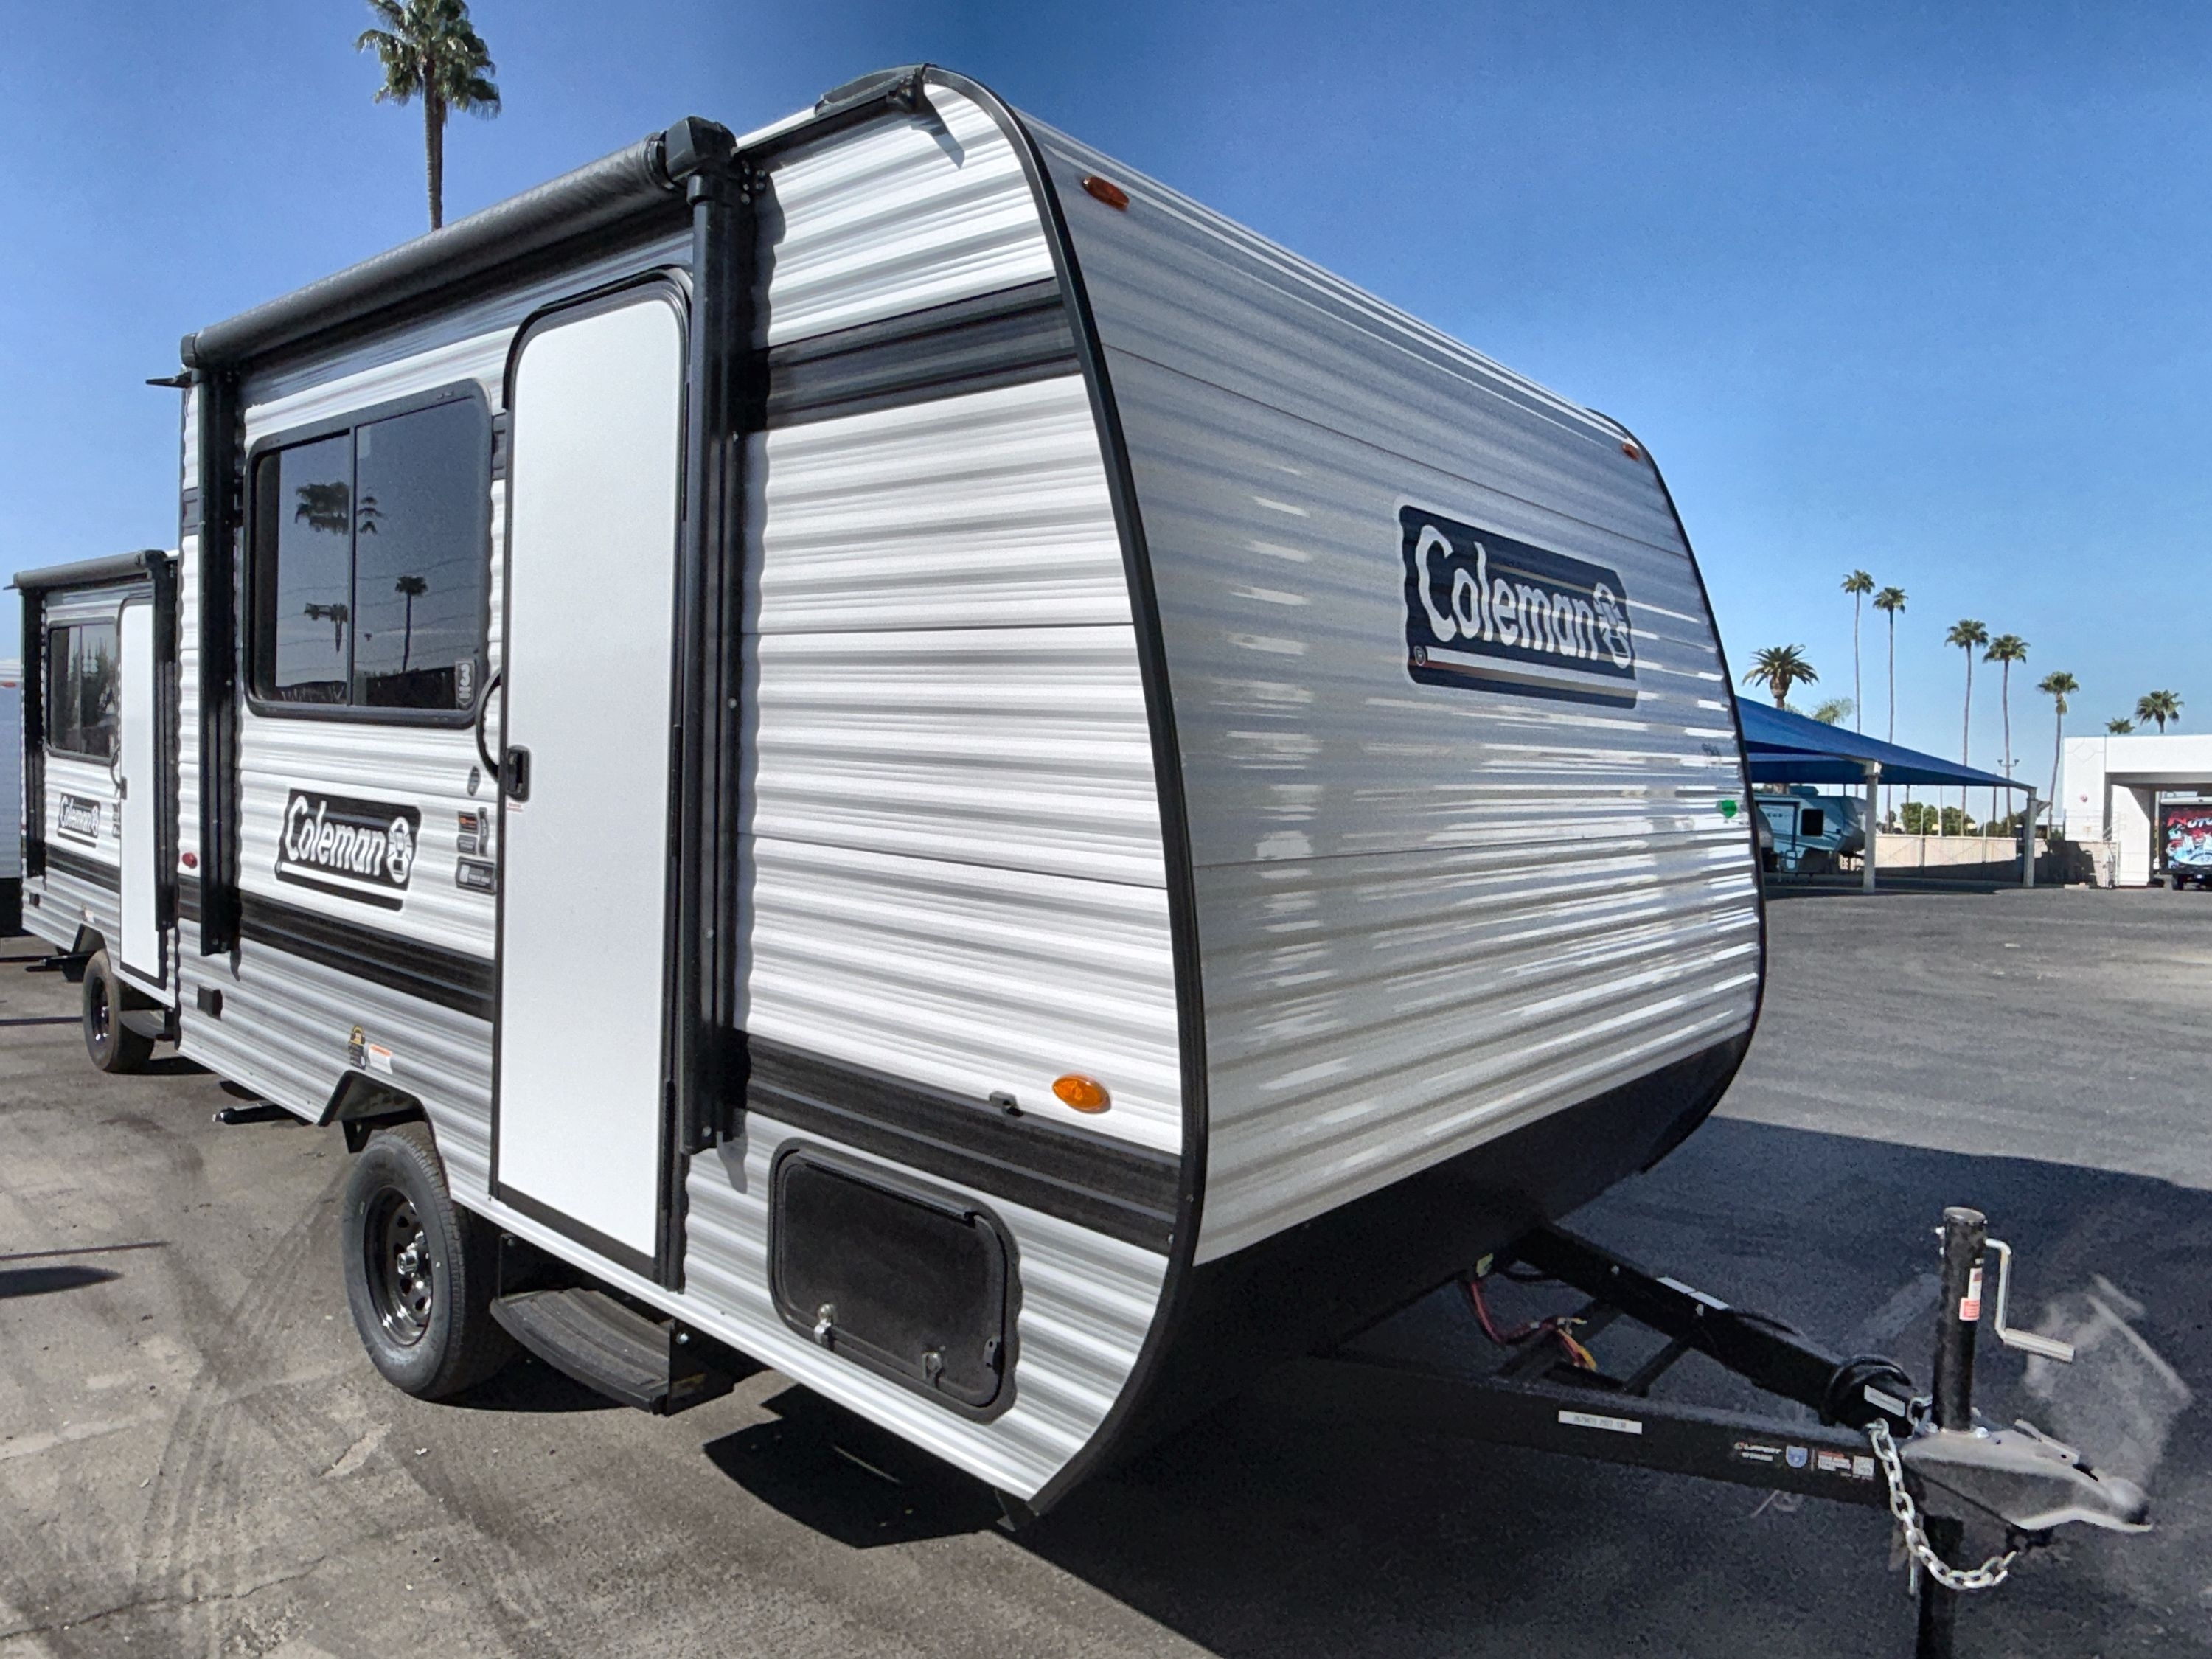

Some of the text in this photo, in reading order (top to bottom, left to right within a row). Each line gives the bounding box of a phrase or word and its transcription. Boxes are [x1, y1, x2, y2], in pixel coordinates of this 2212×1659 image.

[1415, 524, 1599, 661] Coleman
[459, 664, 470, 686] 3
[60, 795, 92, 833] Coleman
[285, 795, 386, 877] Coleman
